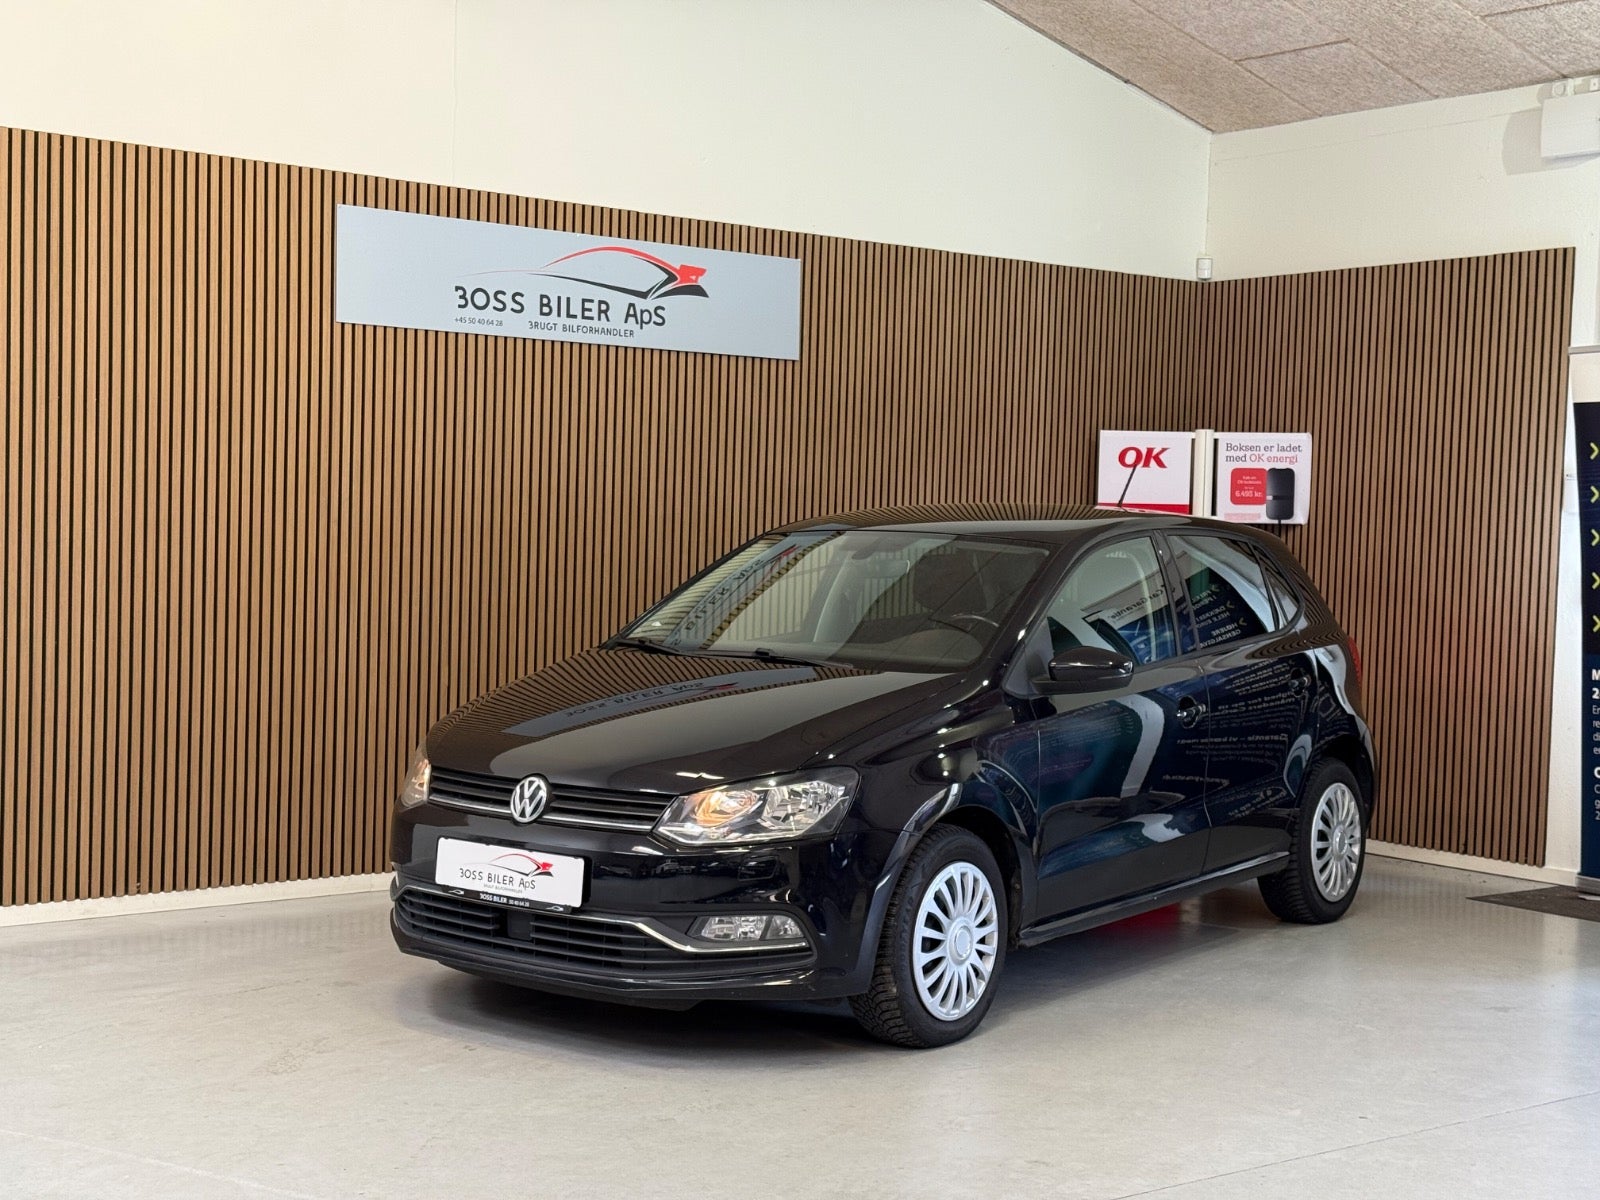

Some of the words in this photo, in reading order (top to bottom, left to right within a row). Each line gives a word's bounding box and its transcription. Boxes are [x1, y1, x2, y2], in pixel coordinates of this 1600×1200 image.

[539, 294, 611, 322] BILER
[624, 302, 667, 330] ApS
[454, 317, 467, 325] +45
[477, 318, 486, 326] 40
[562, 323, 635, 338] BILFORHANDLER
[1225, 442, 1262, 452] Boksen
[1276, 443, 1303, 453] ladet
[1118, 446, 1171, 469] OK
[1225, 453, 1247, 463] med
[1249, 453, 1265, 463] OK
[1266, 454, 1298, 465] energi
[487, 872, 514, 888] BILER
[518, 878, 536, 891] ApS
